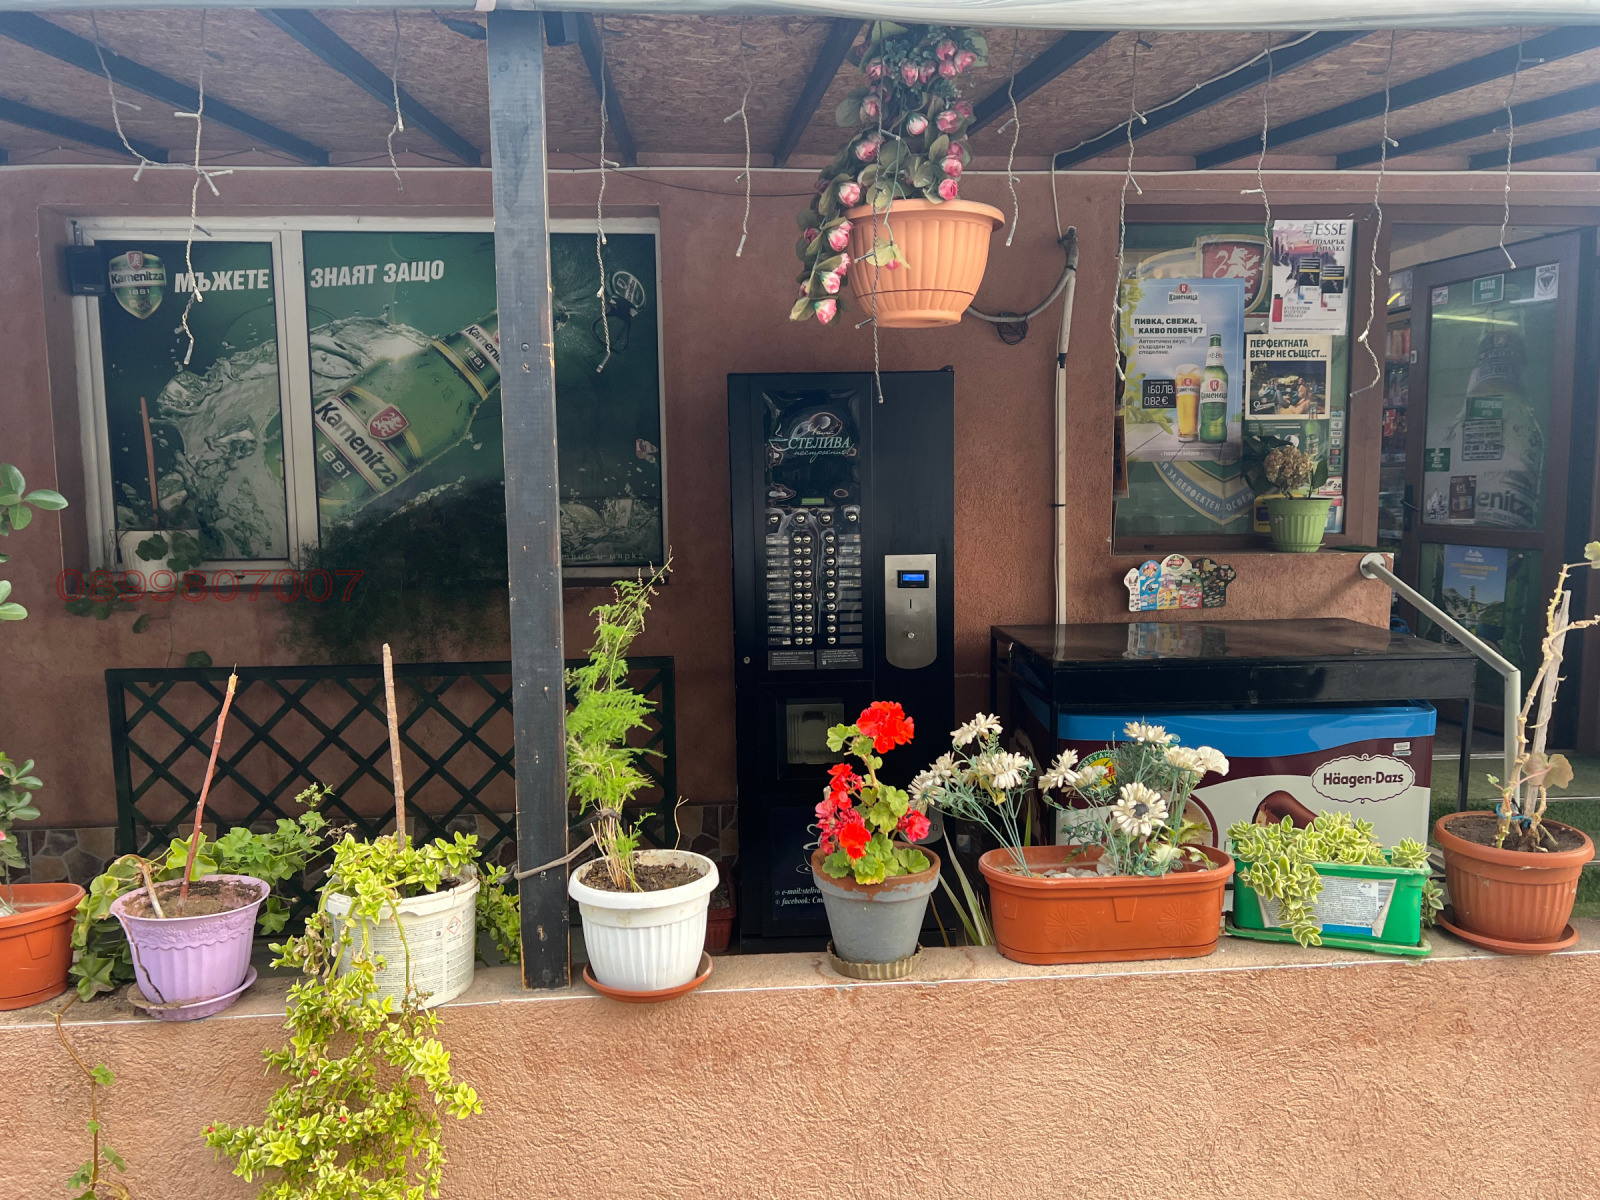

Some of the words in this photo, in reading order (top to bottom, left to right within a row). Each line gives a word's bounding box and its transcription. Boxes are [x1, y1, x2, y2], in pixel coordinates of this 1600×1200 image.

[1315, 223, 1347, 236] ESSE
[110, 271, 165, 285] Kamenitza
[174, 269, 270, 293] МЪЖЕТЕ
[310, 264, 378, 288] ЗНАЯТ
[383, 260, 445, 283] ЗАЩО
[128, 288, 151, 296] 1881
[465, 324, 500, 368] Kameni
[1250, 339, 1309, 349] ПЕРФЕКТНАТА
[1250, 349, 1275, 358] ВЕЧЕР
[1276, 350, 1287, 358] НЕ
[315, 401, 399, 487] Kamenitza
[788, 436, 850, 450] СТЕЛИВА
[317, 442, 352, 479] 1881
[1323, 771, 1404, 788] Häagen-Dazs
[781, 896, 811, 907] facebook:
